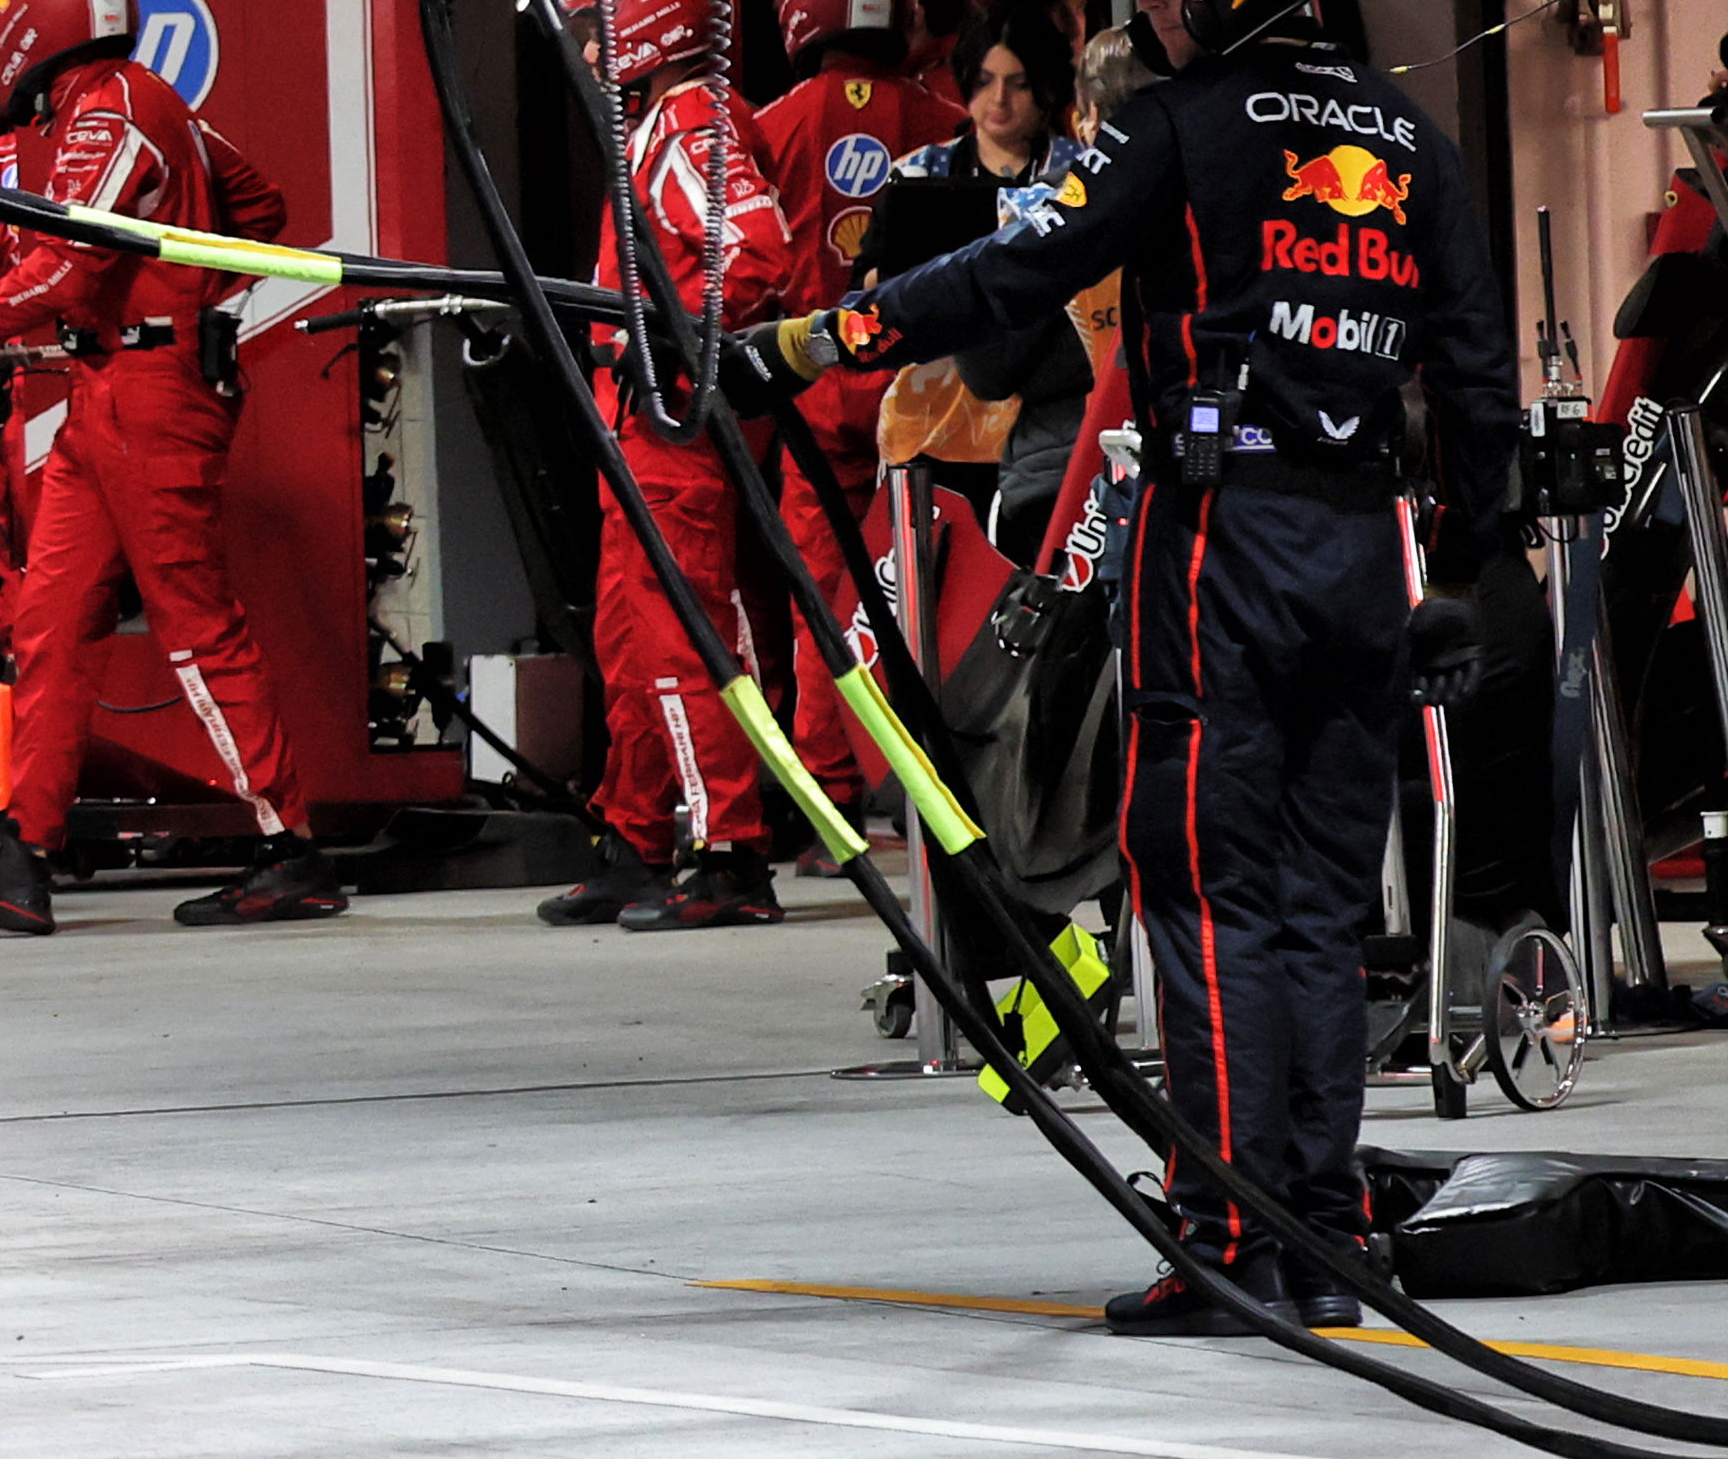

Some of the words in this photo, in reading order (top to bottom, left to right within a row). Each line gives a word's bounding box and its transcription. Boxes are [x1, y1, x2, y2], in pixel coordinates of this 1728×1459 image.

[1245, 91, 1416, 152] ORACLE
[832, 136, 887, 197] hp
[1261, 219, 1350, 277] Red
[1269, 300, 1379, 354] Mobil
[1381, 318, 1403, 358] 1
